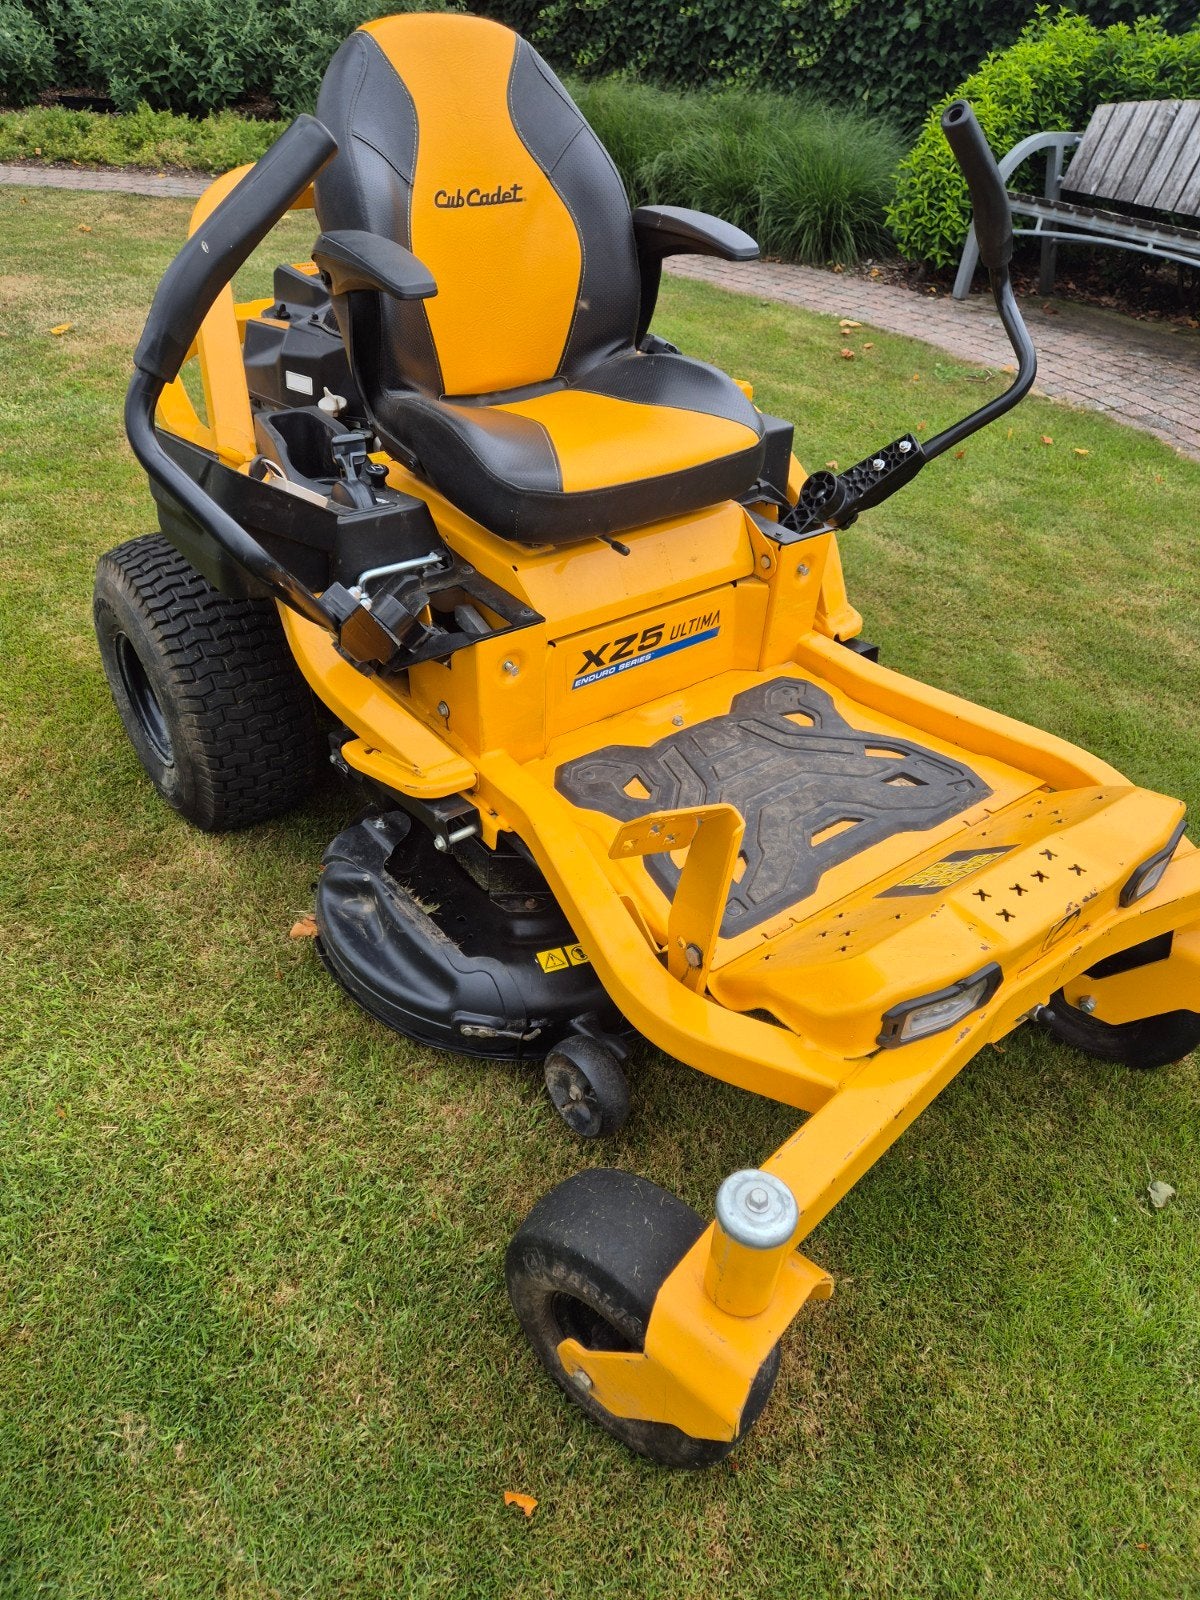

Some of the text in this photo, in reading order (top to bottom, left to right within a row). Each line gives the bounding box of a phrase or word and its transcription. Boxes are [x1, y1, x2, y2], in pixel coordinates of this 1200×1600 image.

[434, 183, 523, 208] Cub Cadet
[576, 609, 720, 675] XZ5 ULTIMA
[574, 653, 653, 687] ENDURO SERIES
